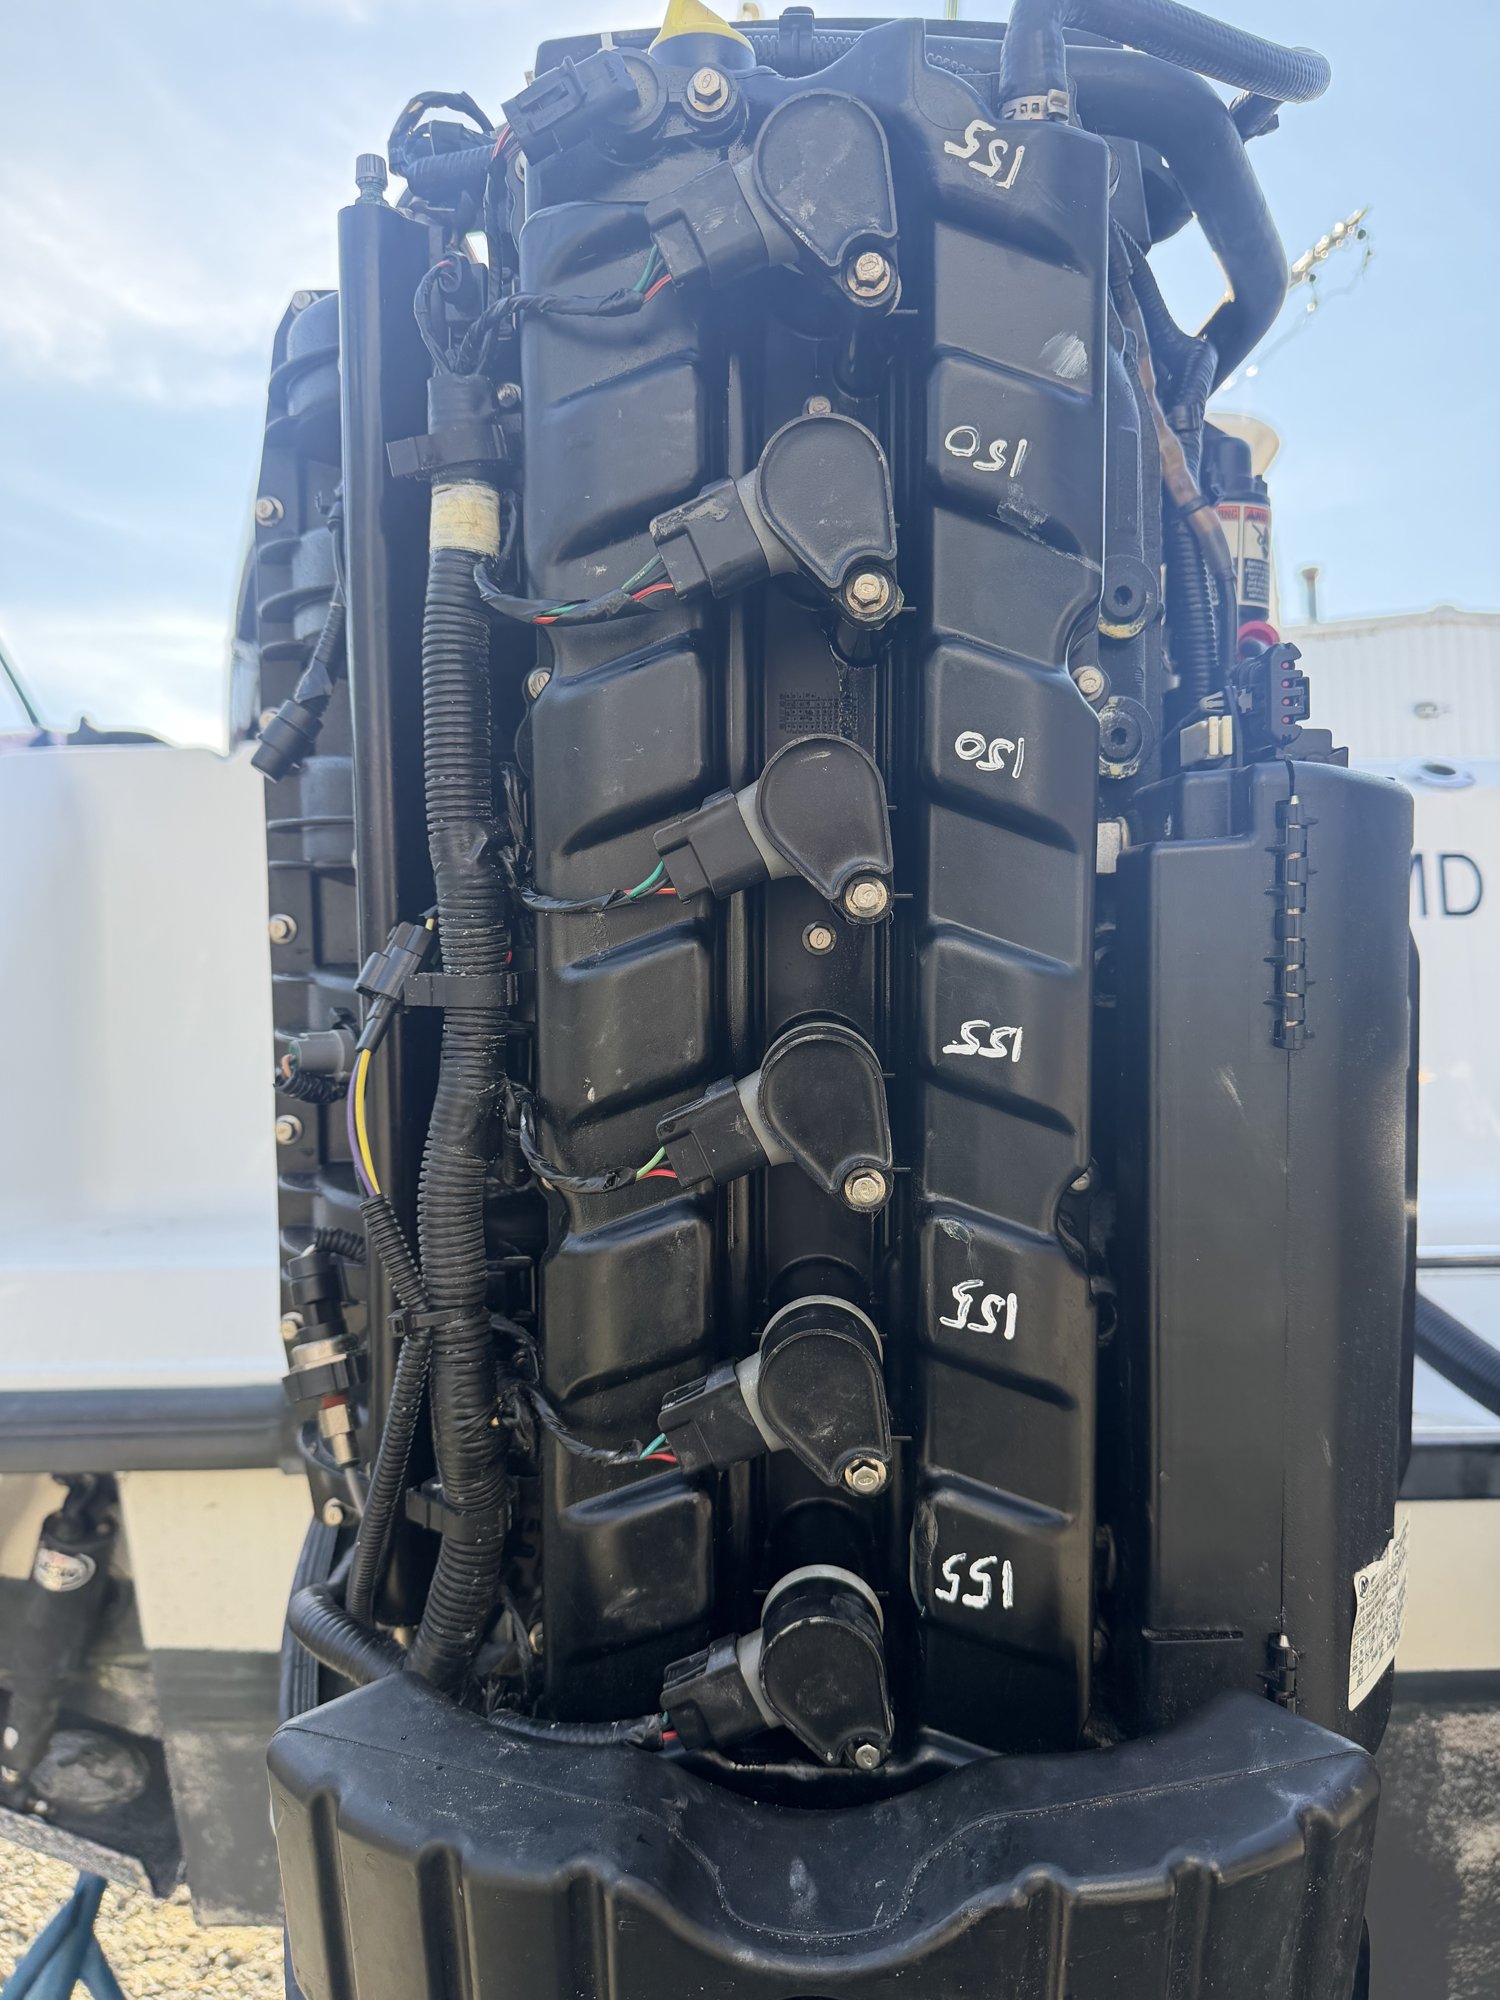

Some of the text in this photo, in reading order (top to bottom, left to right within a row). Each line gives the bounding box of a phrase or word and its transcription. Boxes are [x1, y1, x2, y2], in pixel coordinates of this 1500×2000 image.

[943, 119, 1026, 190] 155
[944, 424, 1028, 478] 150
[954, 730, 1025, 779] 150
[942, 1019, 1024, 1063] 155
[939, 1278, 1019, 1341] 155
[934, 1551, 1014, 1610] 155
